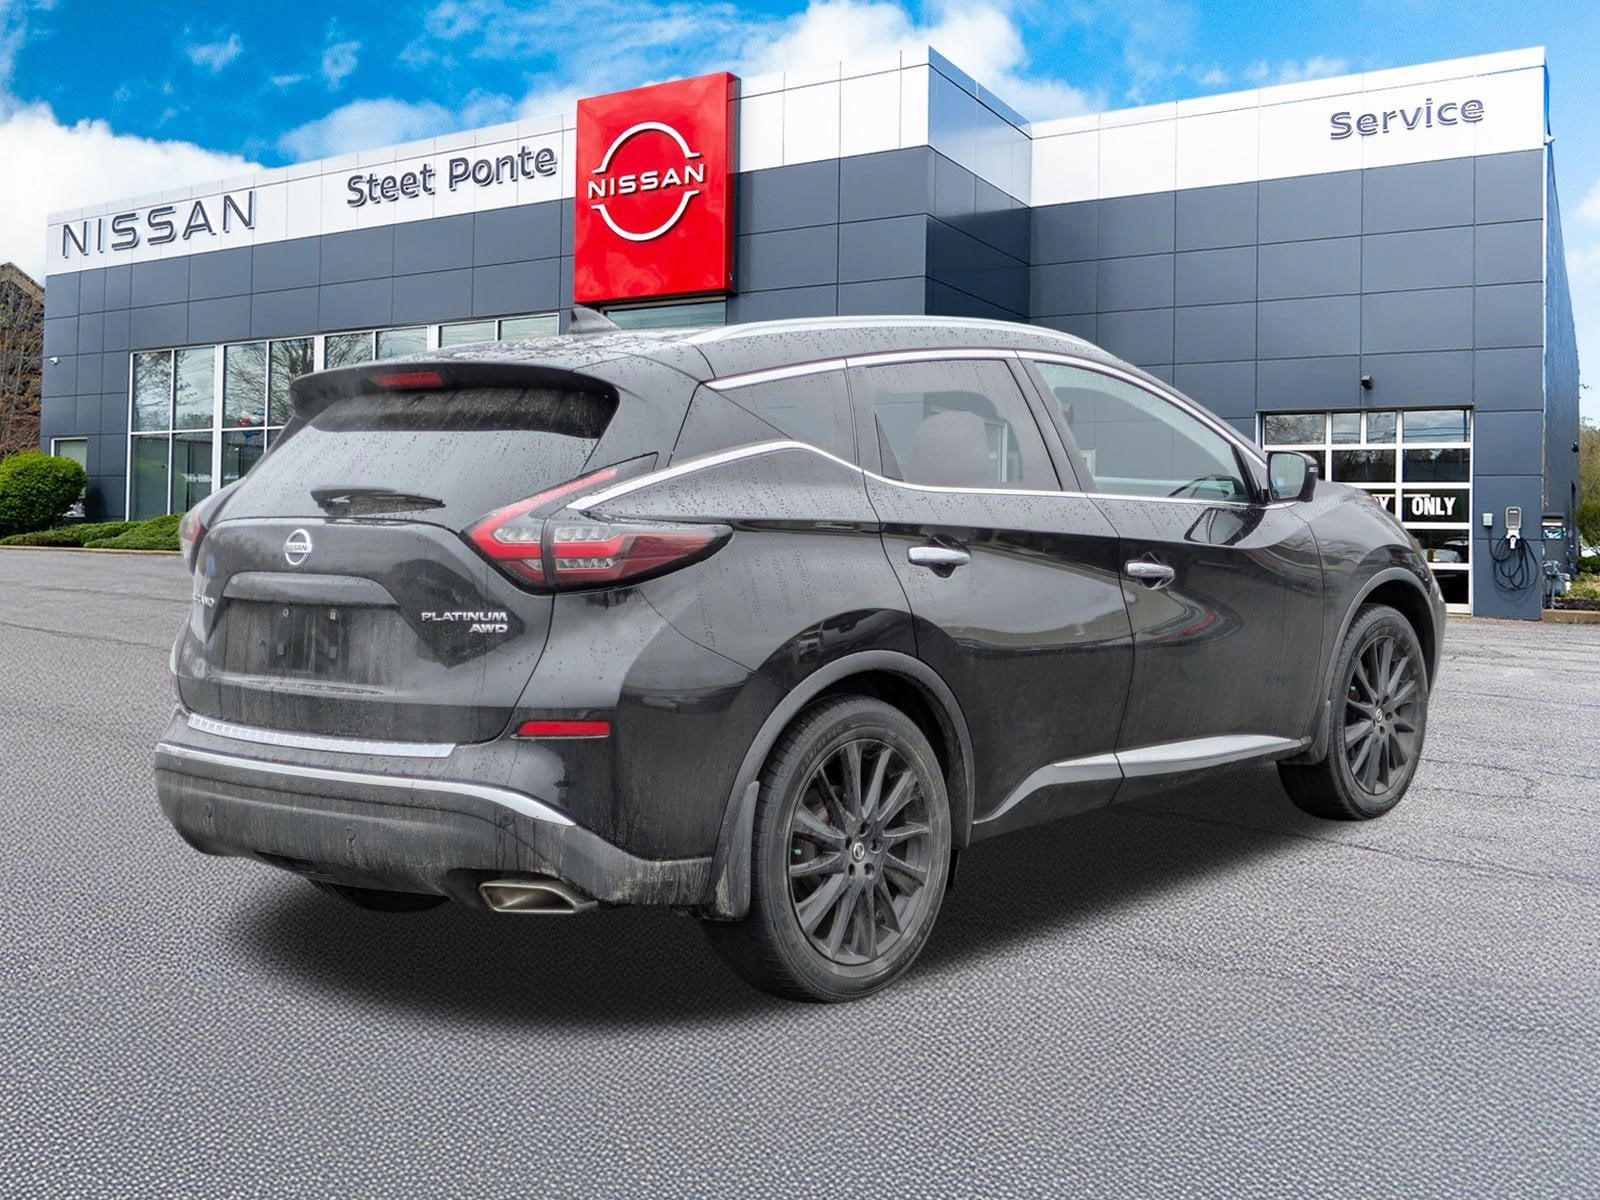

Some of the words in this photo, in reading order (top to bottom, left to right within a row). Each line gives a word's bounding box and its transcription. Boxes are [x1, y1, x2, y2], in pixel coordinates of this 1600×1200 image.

[1330, 98, 1485, 140] Service
[347, 163, 435, 207] Steet
[449, 146, 558, 192] Ponte
[586, 163, 705, 200] NISSAN
[62, 190, 255, 259] NISSAN
[1411, 497, 1456, 516] ONLY
[421, 611, 508, 622] PLATINUM
[469, 623, 508, 634] AWD
